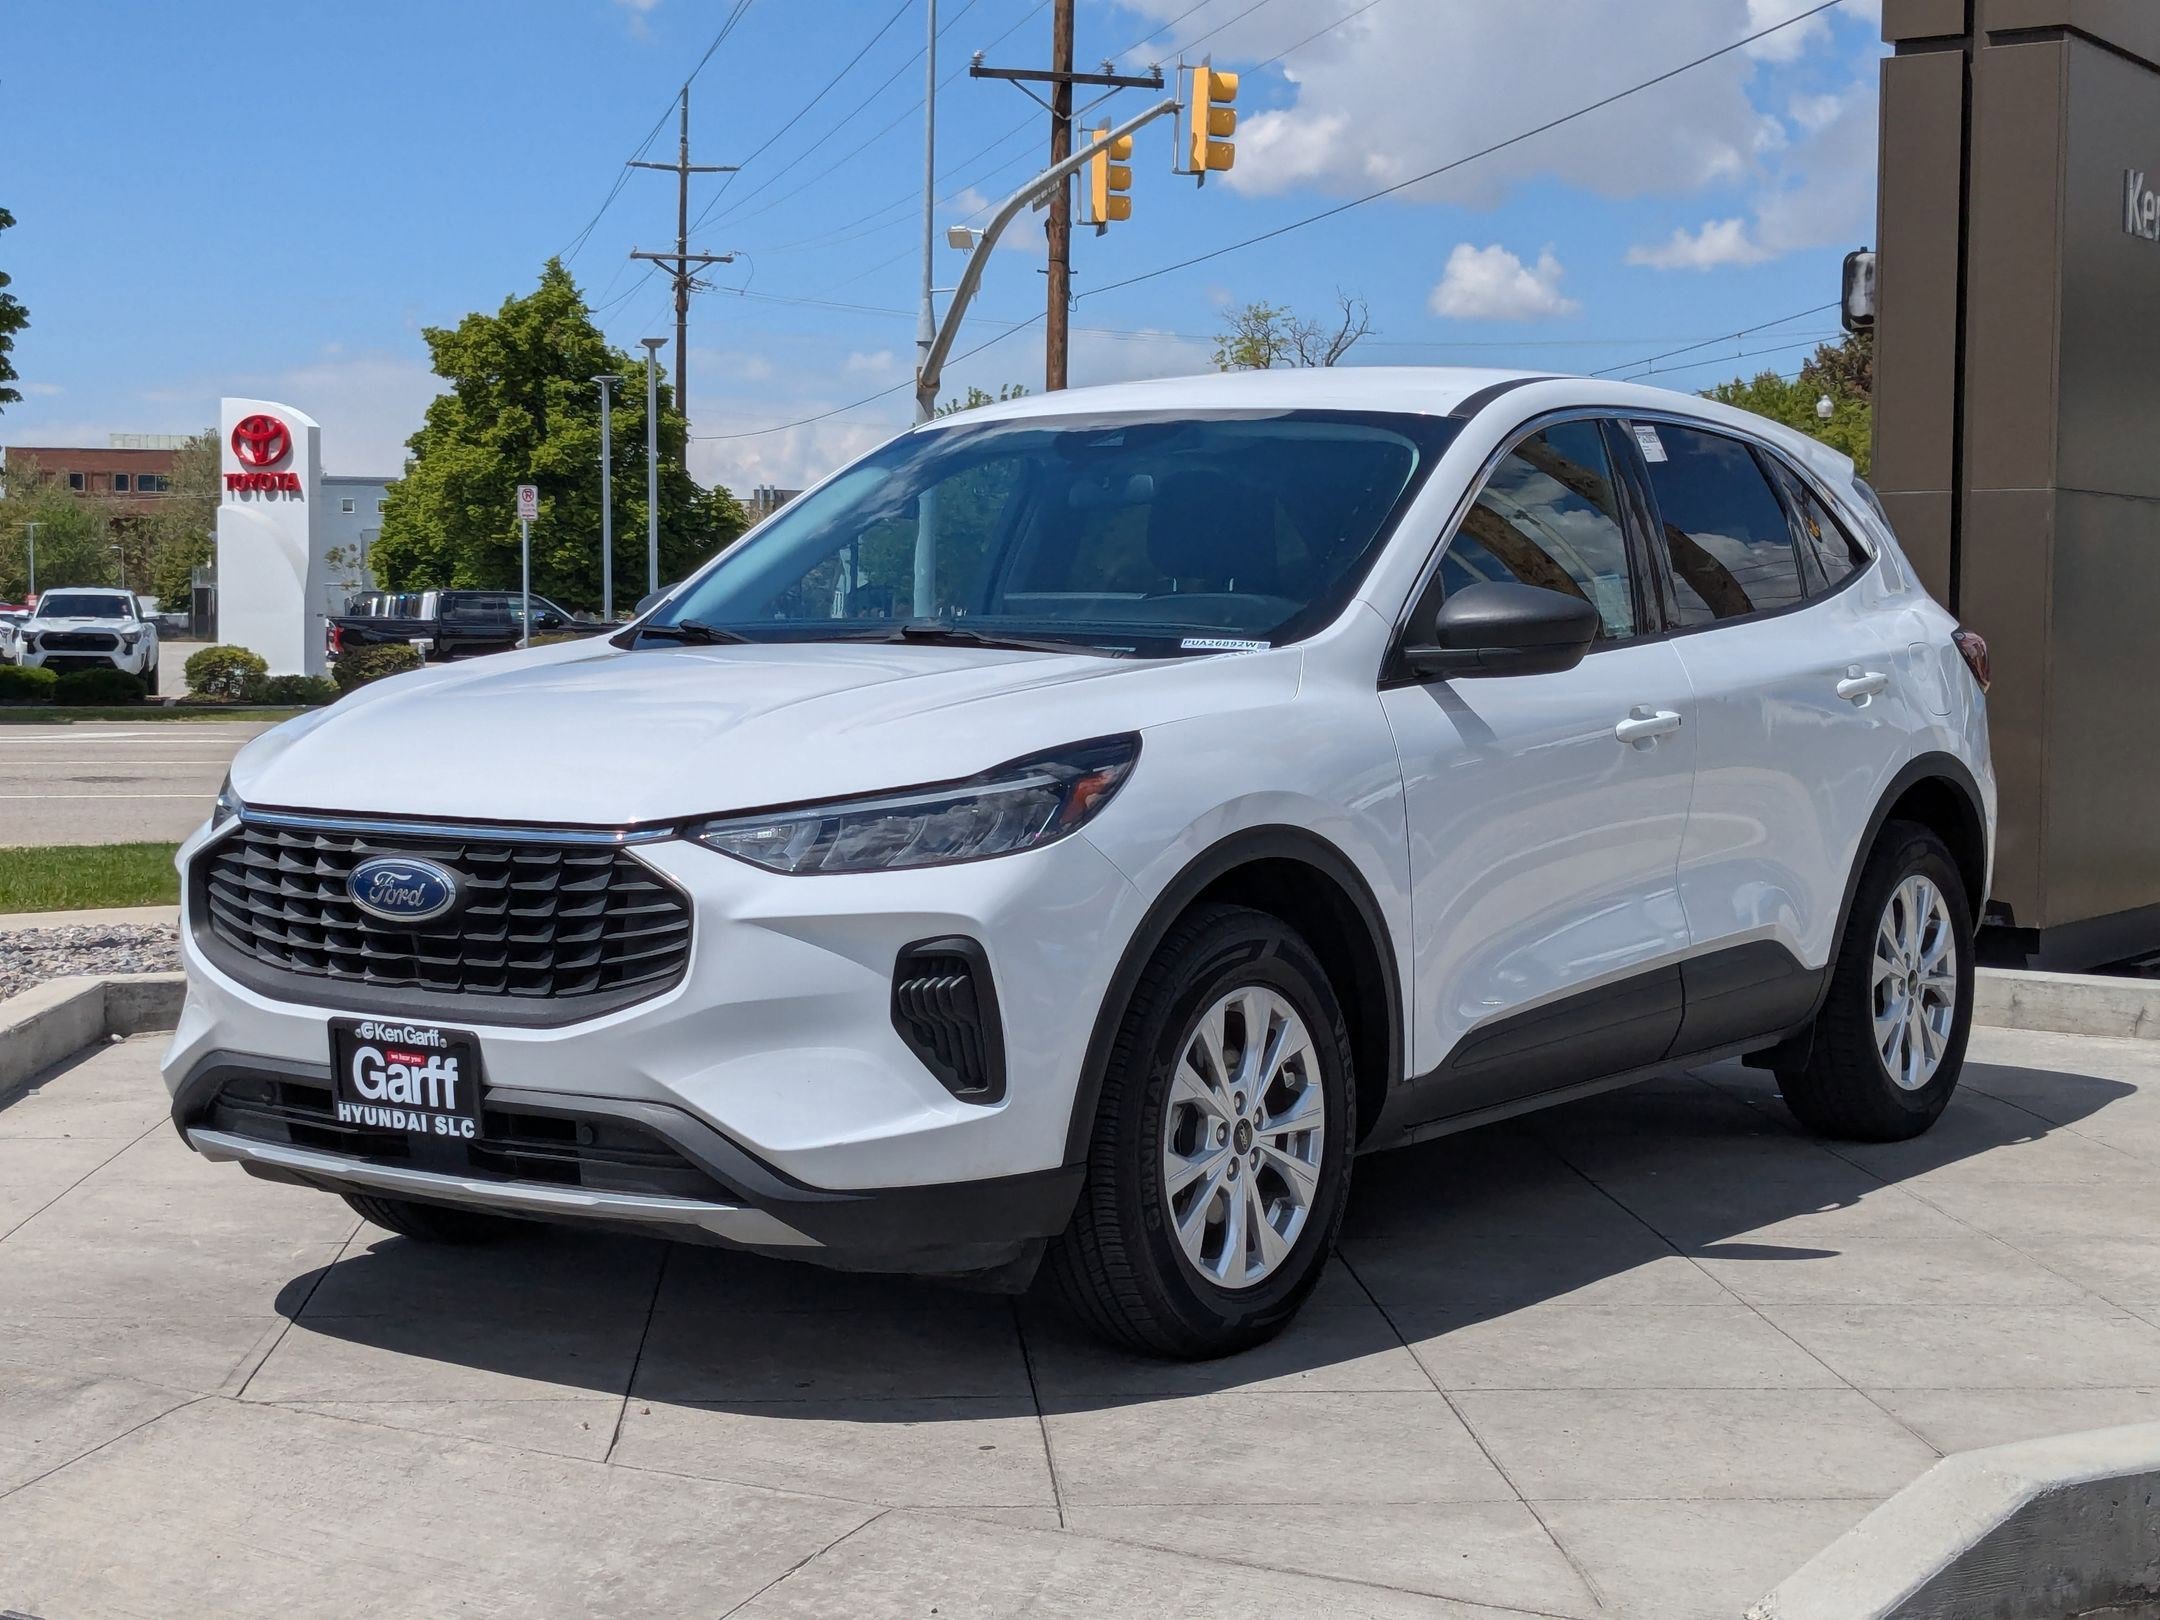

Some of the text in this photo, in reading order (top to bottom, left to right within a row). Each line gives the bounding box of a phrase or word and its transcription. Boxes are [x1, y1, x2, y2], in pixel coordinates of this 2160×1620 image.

[223, 472, 300, 491] TOYOTA
[369, 871, 426, 907] Ford
[353, 1046, 459, 1110] Garff
[338, 1103, 475, 1139] HYUNDAI SLC
